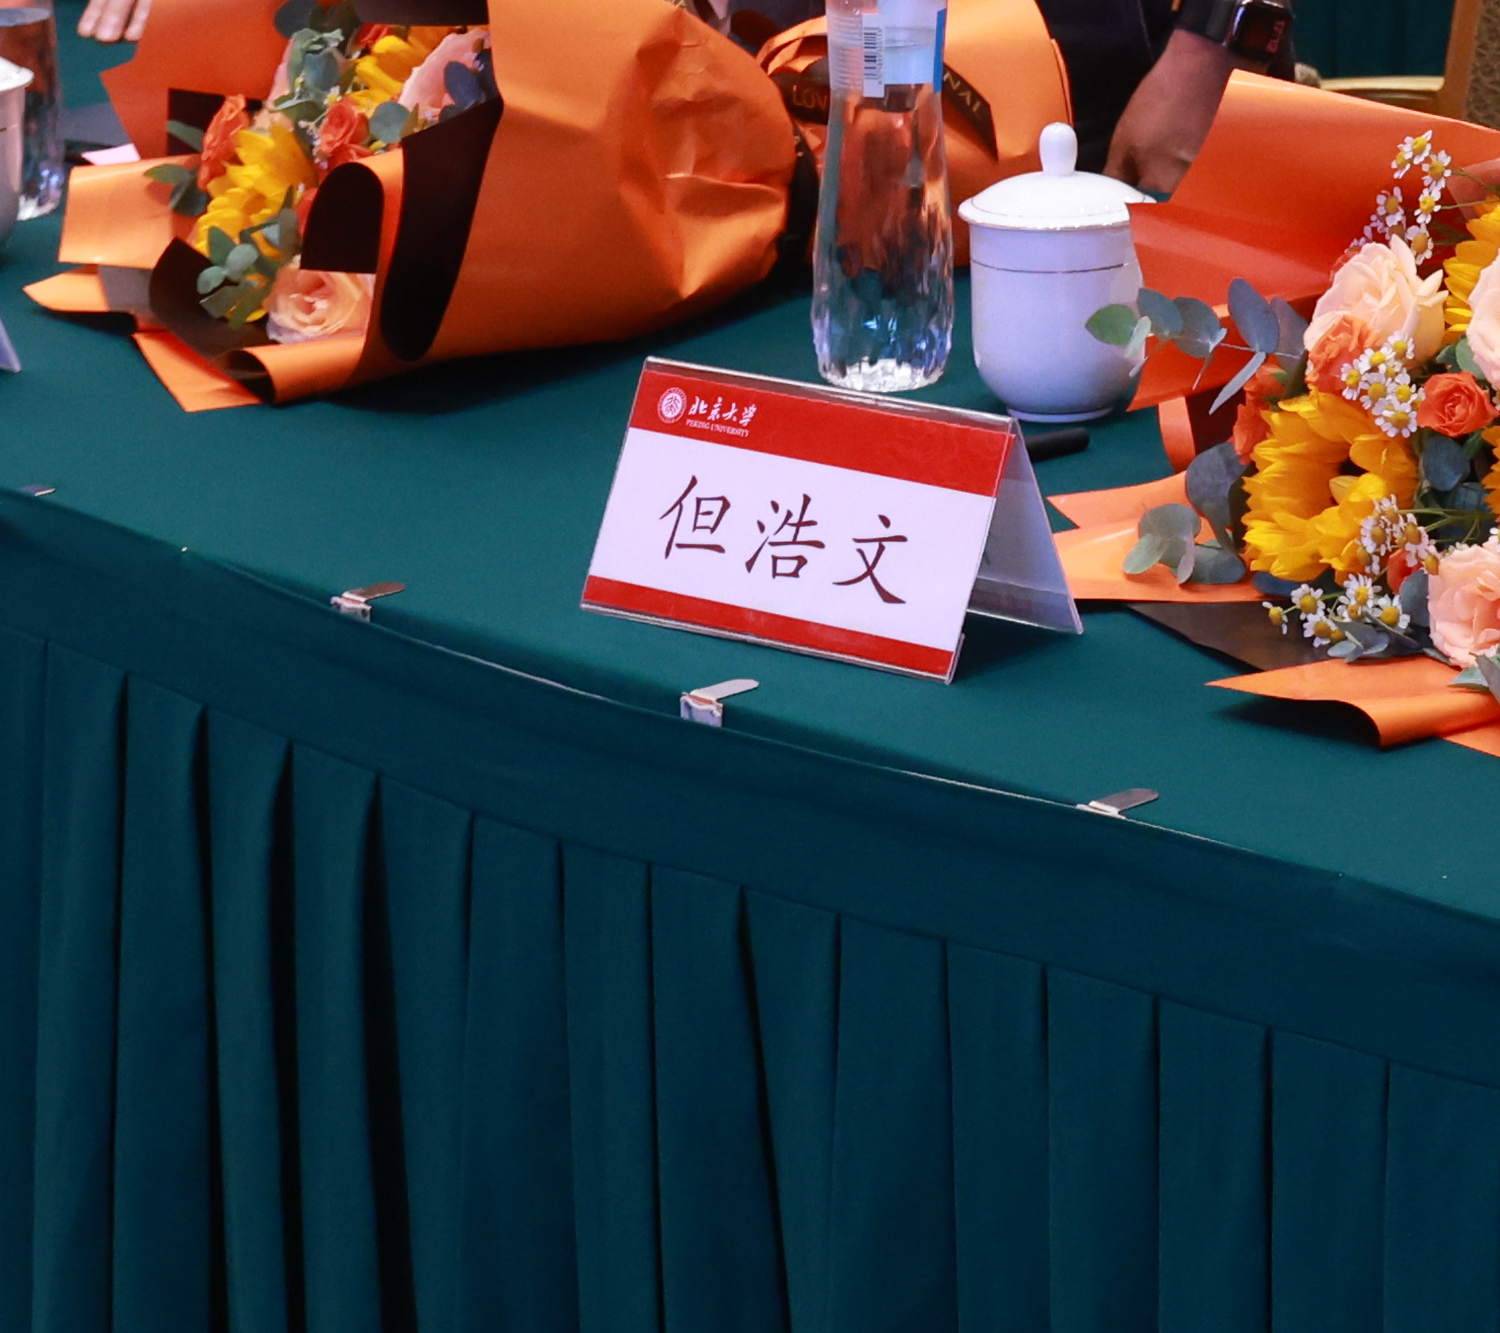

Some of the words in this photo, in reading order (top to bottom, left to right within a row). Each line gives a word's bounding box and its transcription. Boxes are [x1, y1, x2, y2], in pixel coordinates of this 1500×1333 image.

[688, 395, 757, 427] 北京大学
[658, 474, 909, 605] 但浩文
